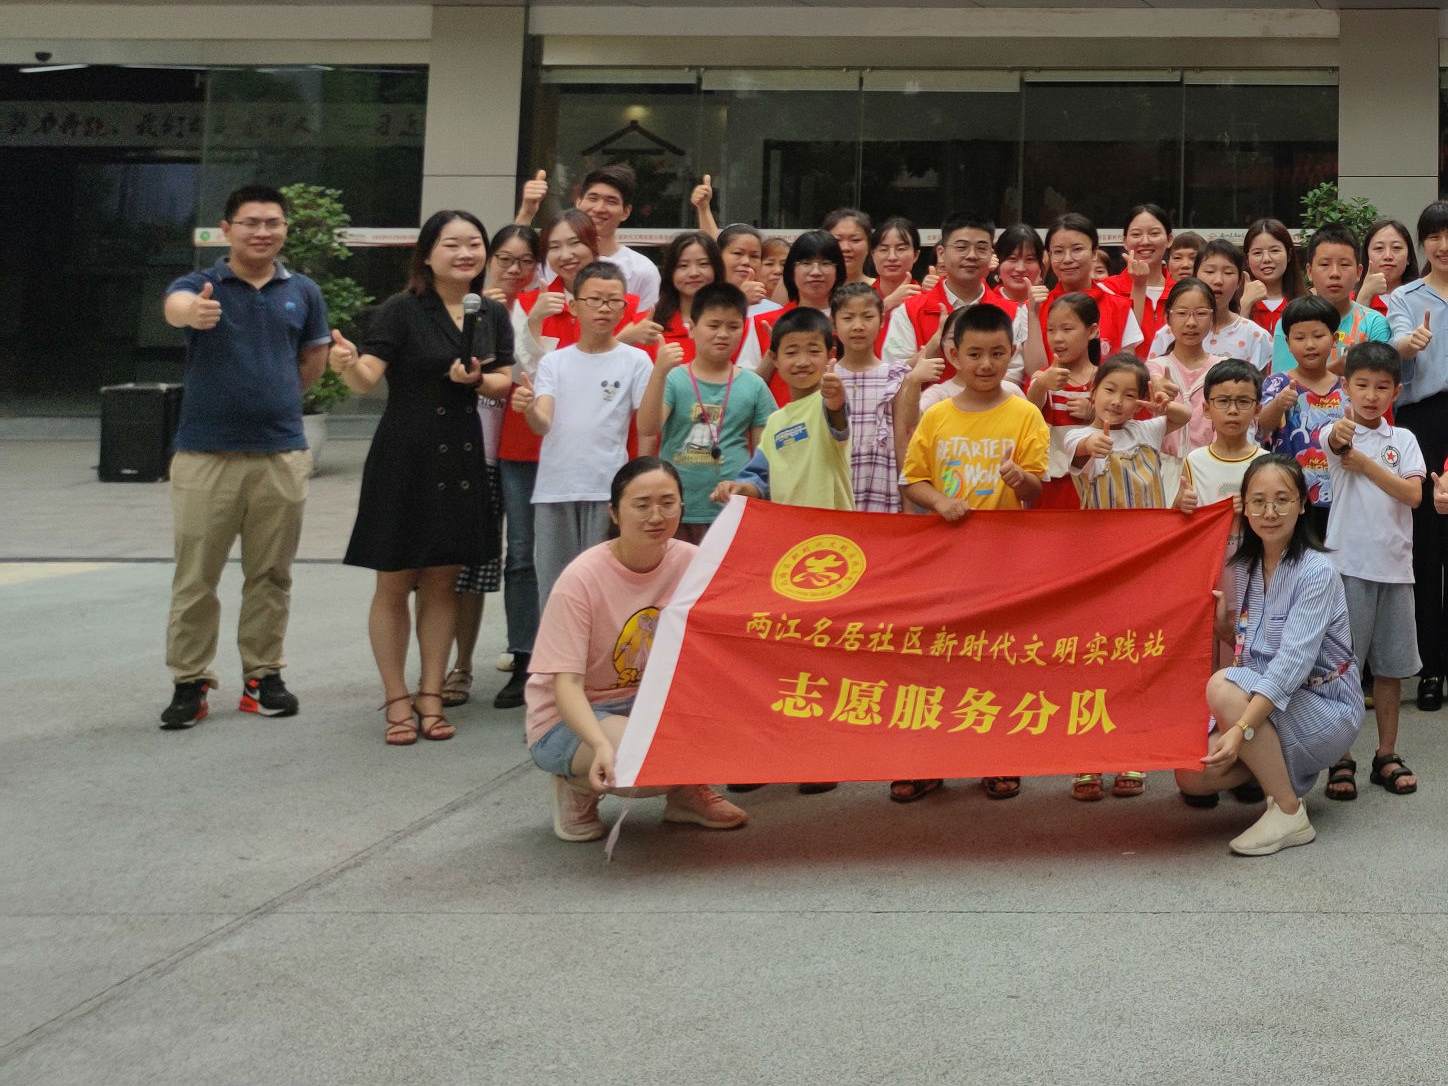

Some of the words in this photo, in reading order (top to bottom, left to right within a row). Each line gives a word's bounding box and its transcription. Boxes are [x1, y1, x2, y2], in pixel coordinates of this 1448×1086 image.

[745, 611, 1166, 666] 两江名居社区新时代文明实践站
[771, 672, 1118, 736] 志愿服务分队
